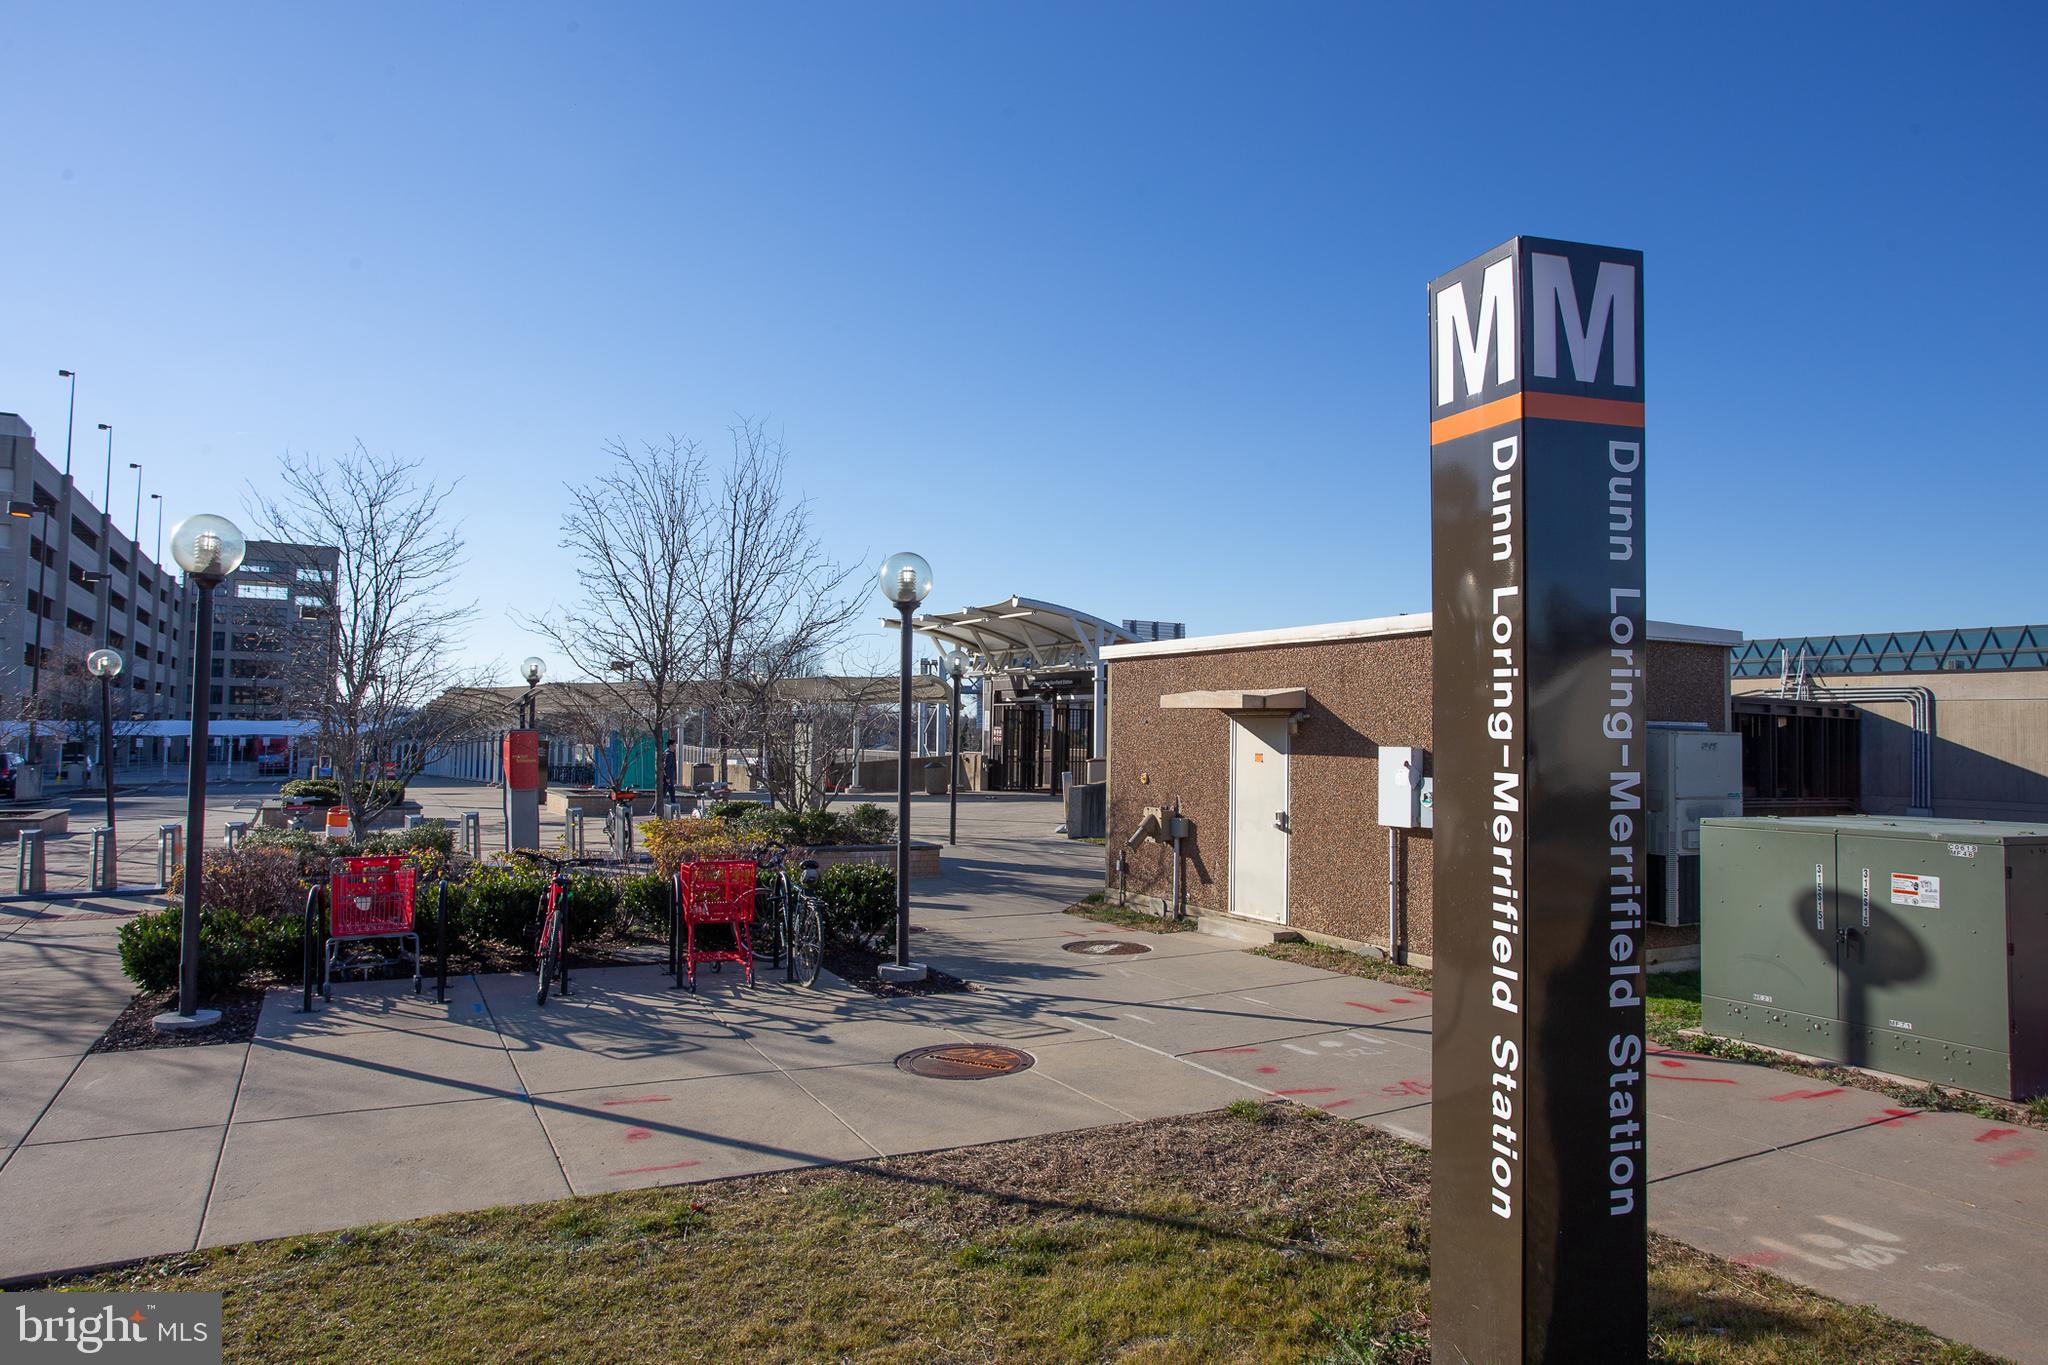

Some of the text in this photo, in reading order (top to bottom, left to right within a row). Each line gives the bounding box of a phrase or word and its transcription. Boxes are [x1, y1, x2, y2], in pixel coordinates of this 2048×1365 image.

[1436, 256, 1516, 407] M
[1531, 252, 1636, 388] M
[1491, 435, 1518, 562] Dunn
[1608, 440, 1641, 561] Dunn
[1491, 1035, 1519, 1219] Station
[1608, 1033, 1642, 1216] Station
